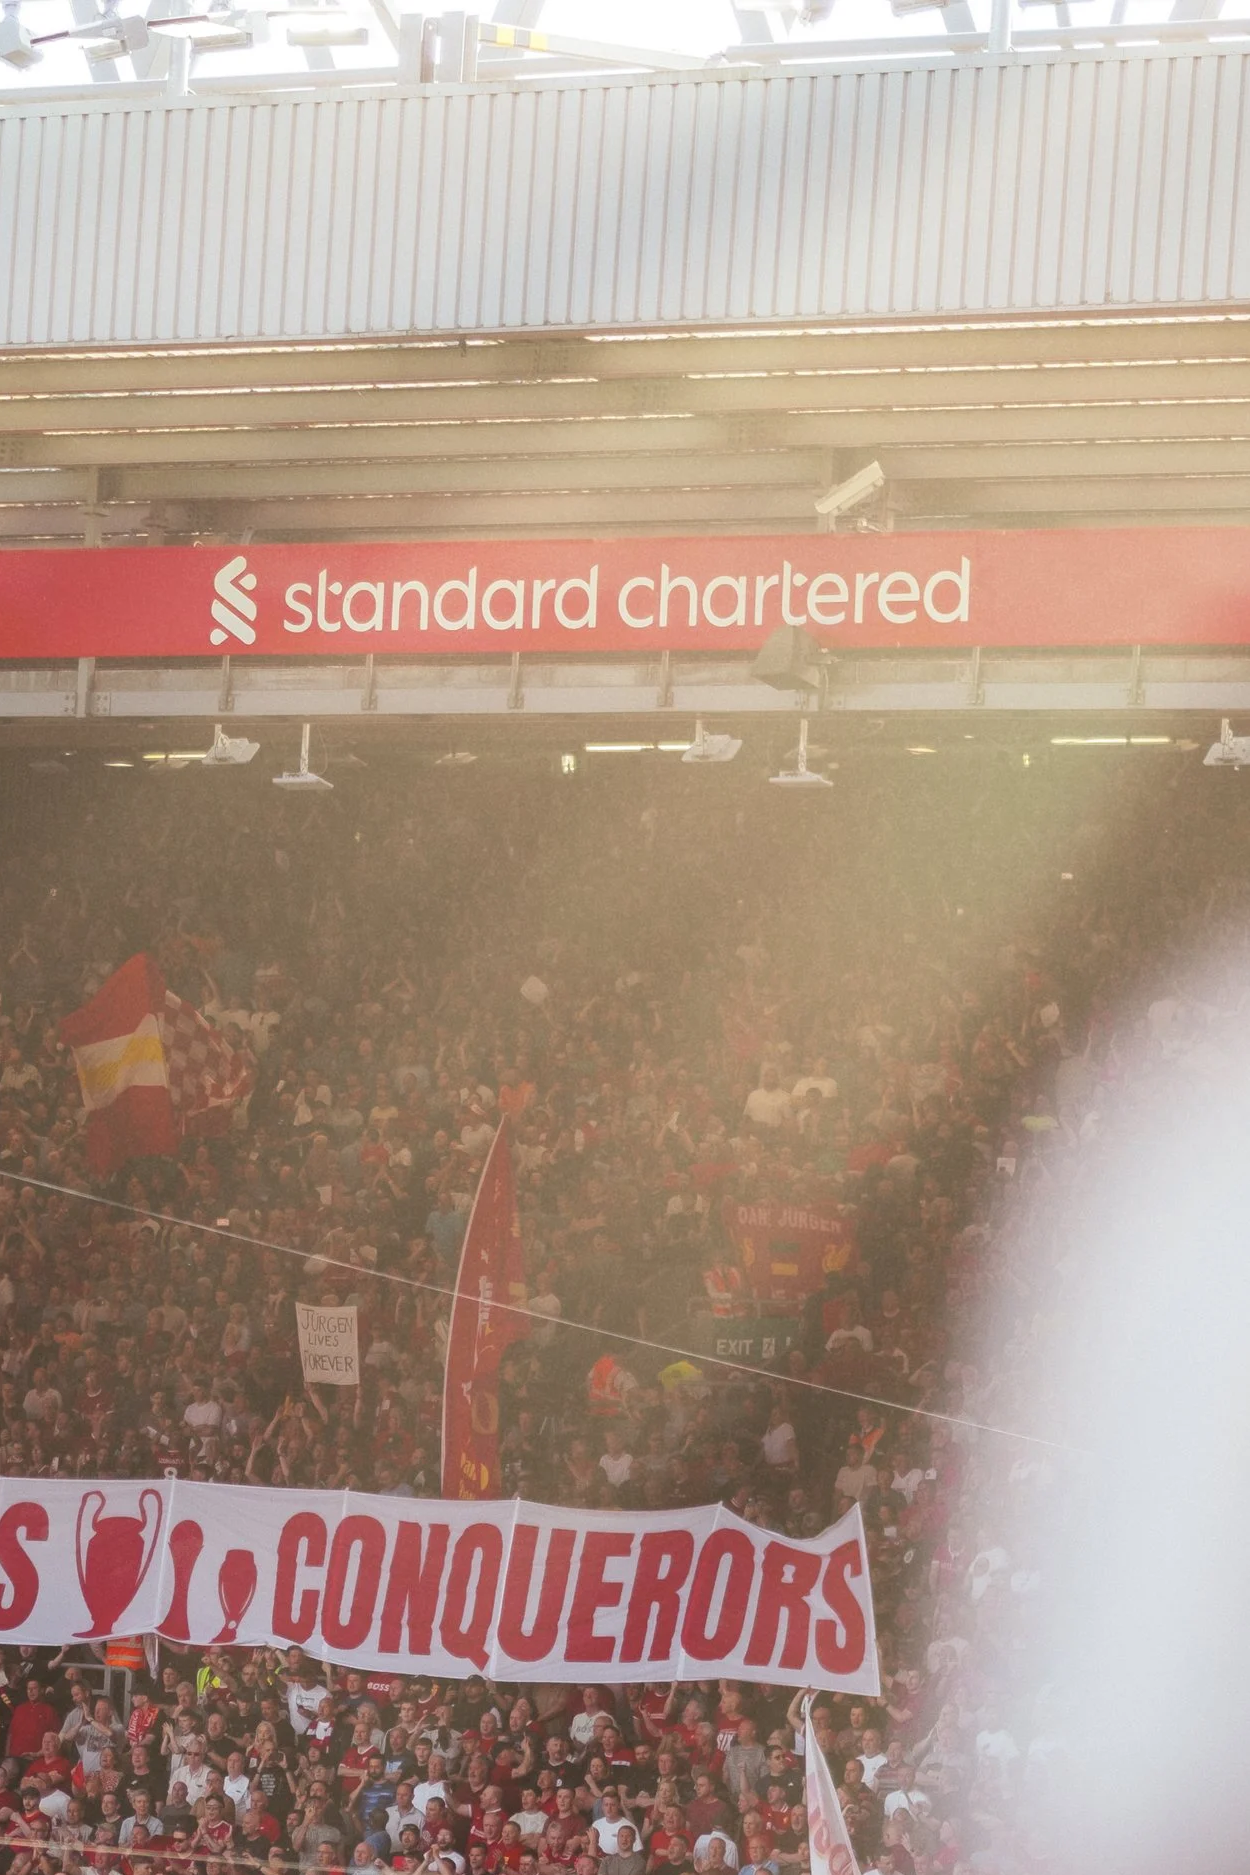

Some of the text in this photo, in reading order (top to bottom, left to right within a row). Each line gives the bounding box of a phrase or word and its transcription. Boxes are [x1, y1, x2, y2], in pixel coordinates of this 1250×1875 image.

[283, 556, 970, 632] standard chartered
[308, 1334, 339, 1348] LIVES
[716, 1339, 753, 1356] EXIT
[271, 1511, 864, 1675] CONQUERORS
